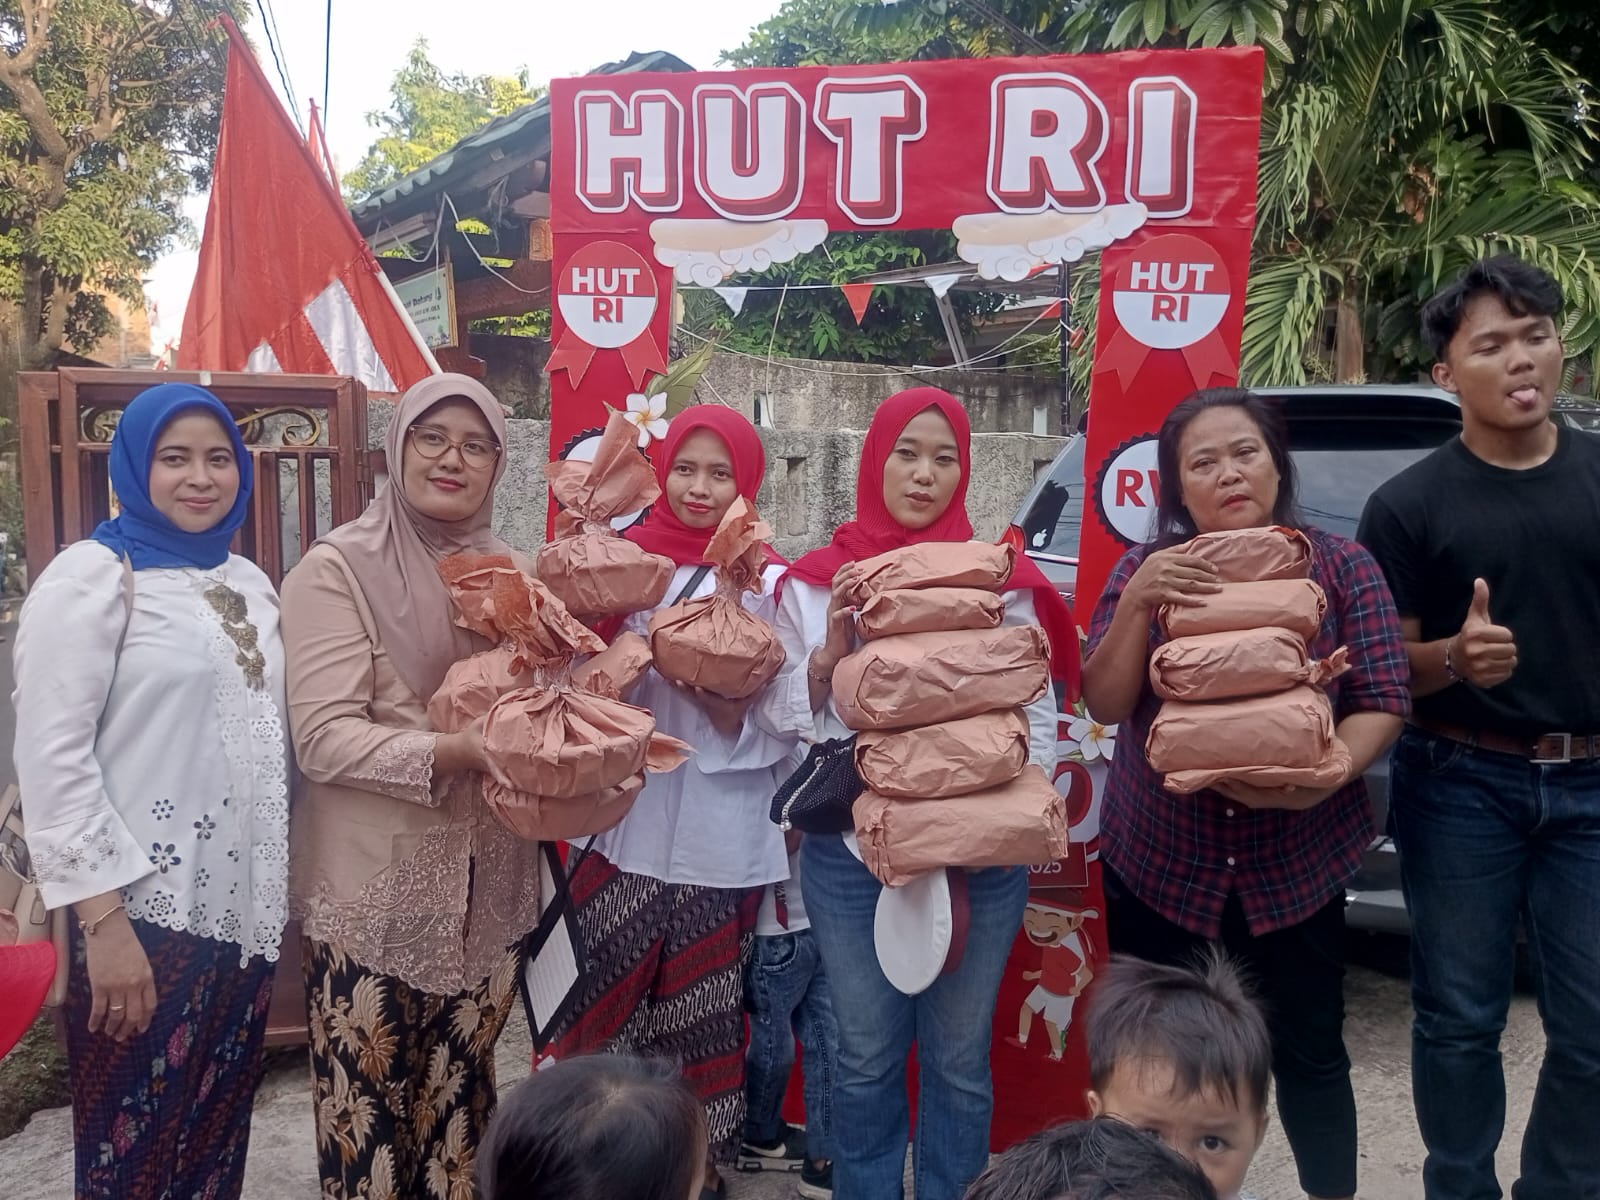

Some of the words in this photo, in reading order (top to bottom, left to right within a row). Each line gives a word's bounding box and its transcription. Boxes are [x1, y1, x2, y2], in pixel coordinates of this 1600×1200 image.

[578, 77, 924, 223] HUT
[987, 73, 1197, 217] RI
[572, 267, 640, 294] HUT
[1130, 261, 1214, 291] HUT
[592, 297, 623, 323] RI
[1151, 294, 1190, 322] RI
[1115, 469, 1160, 508] R
